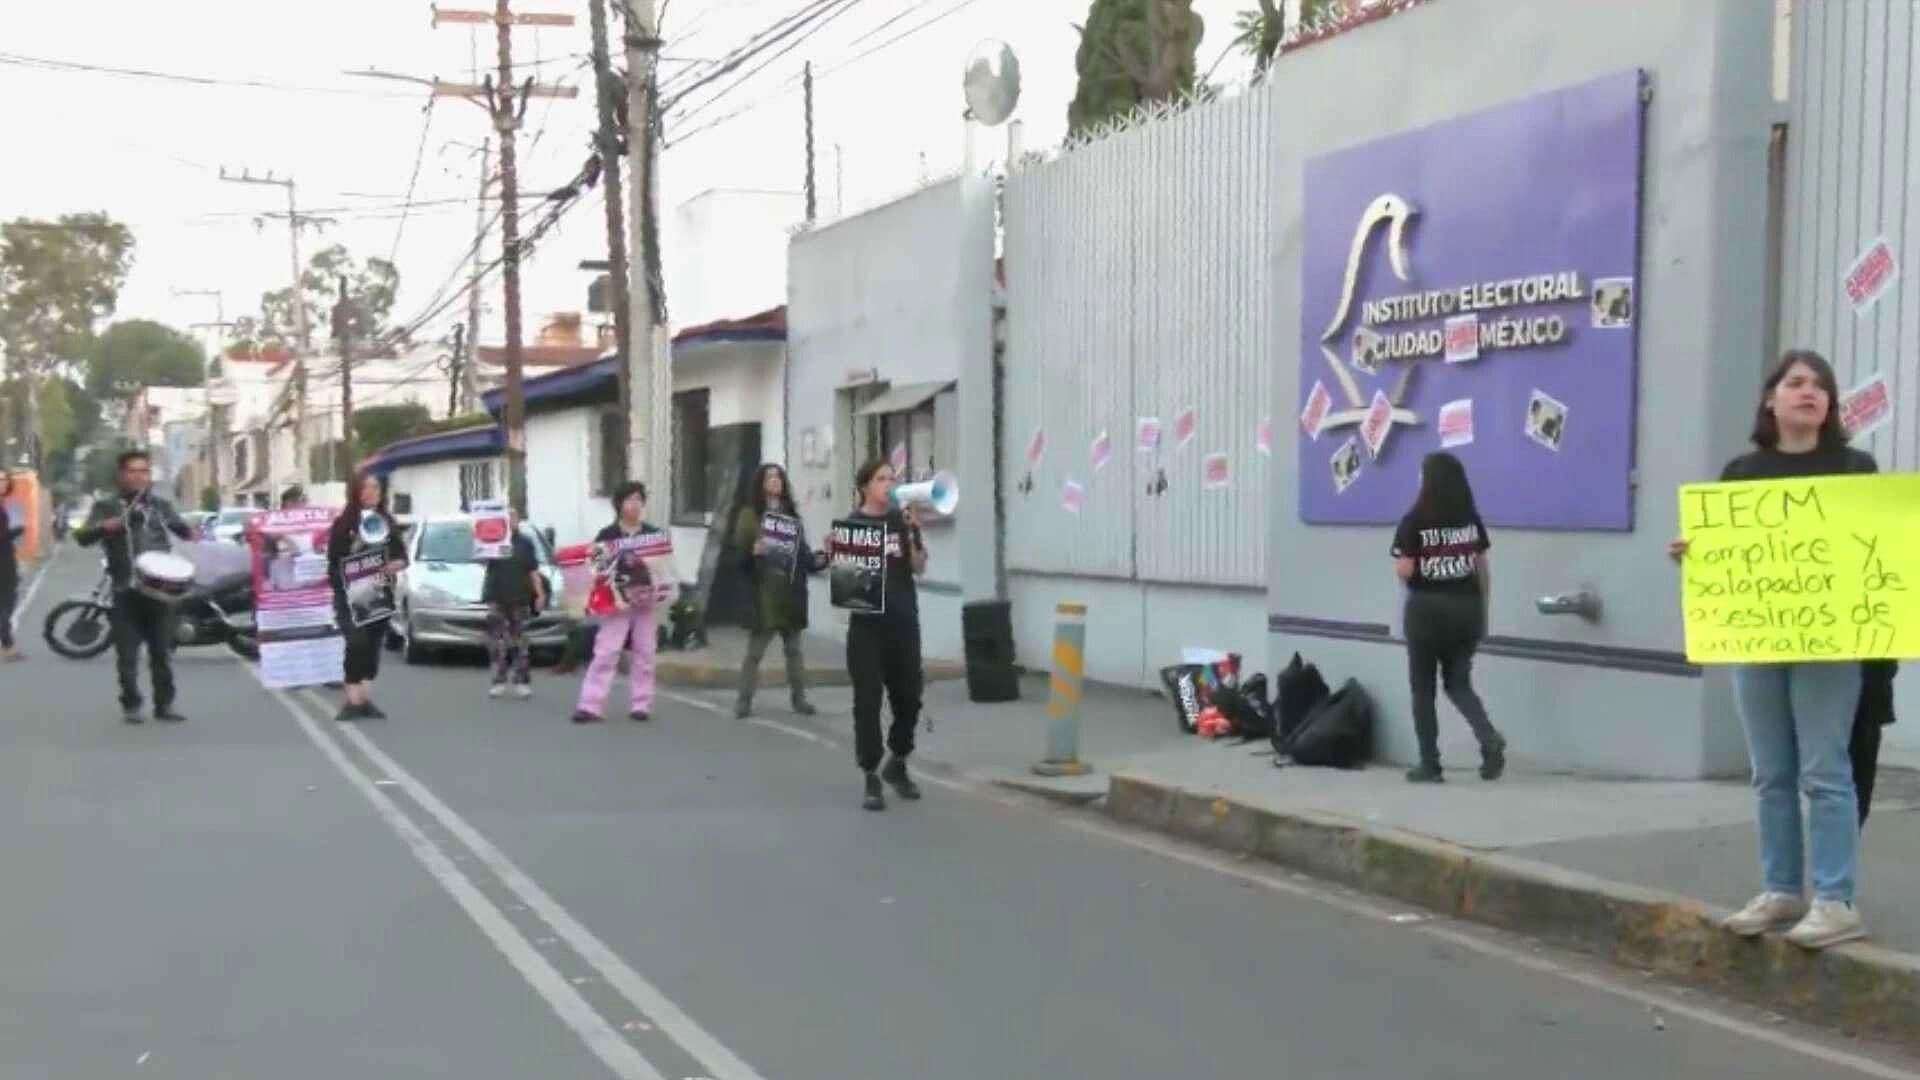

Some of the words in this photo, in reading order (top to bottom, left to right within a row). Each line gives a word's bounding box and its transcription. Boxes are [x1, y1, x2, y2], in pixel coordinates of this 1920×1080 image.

[1363, 289, 1457, 325] INSTITUTO
[1460, 271, 1583, 311] ELECTORAL
[1376, 328, 1442, 360] CIUDAD
[1480, 315, 1564, 349] MÉXICO
[1685, 485, 1826, 530] IECM
[852, 526, 880, 547] MÁS
[1863, 557, 1908, 591] de
[1851, 593, 1894, 628] de
